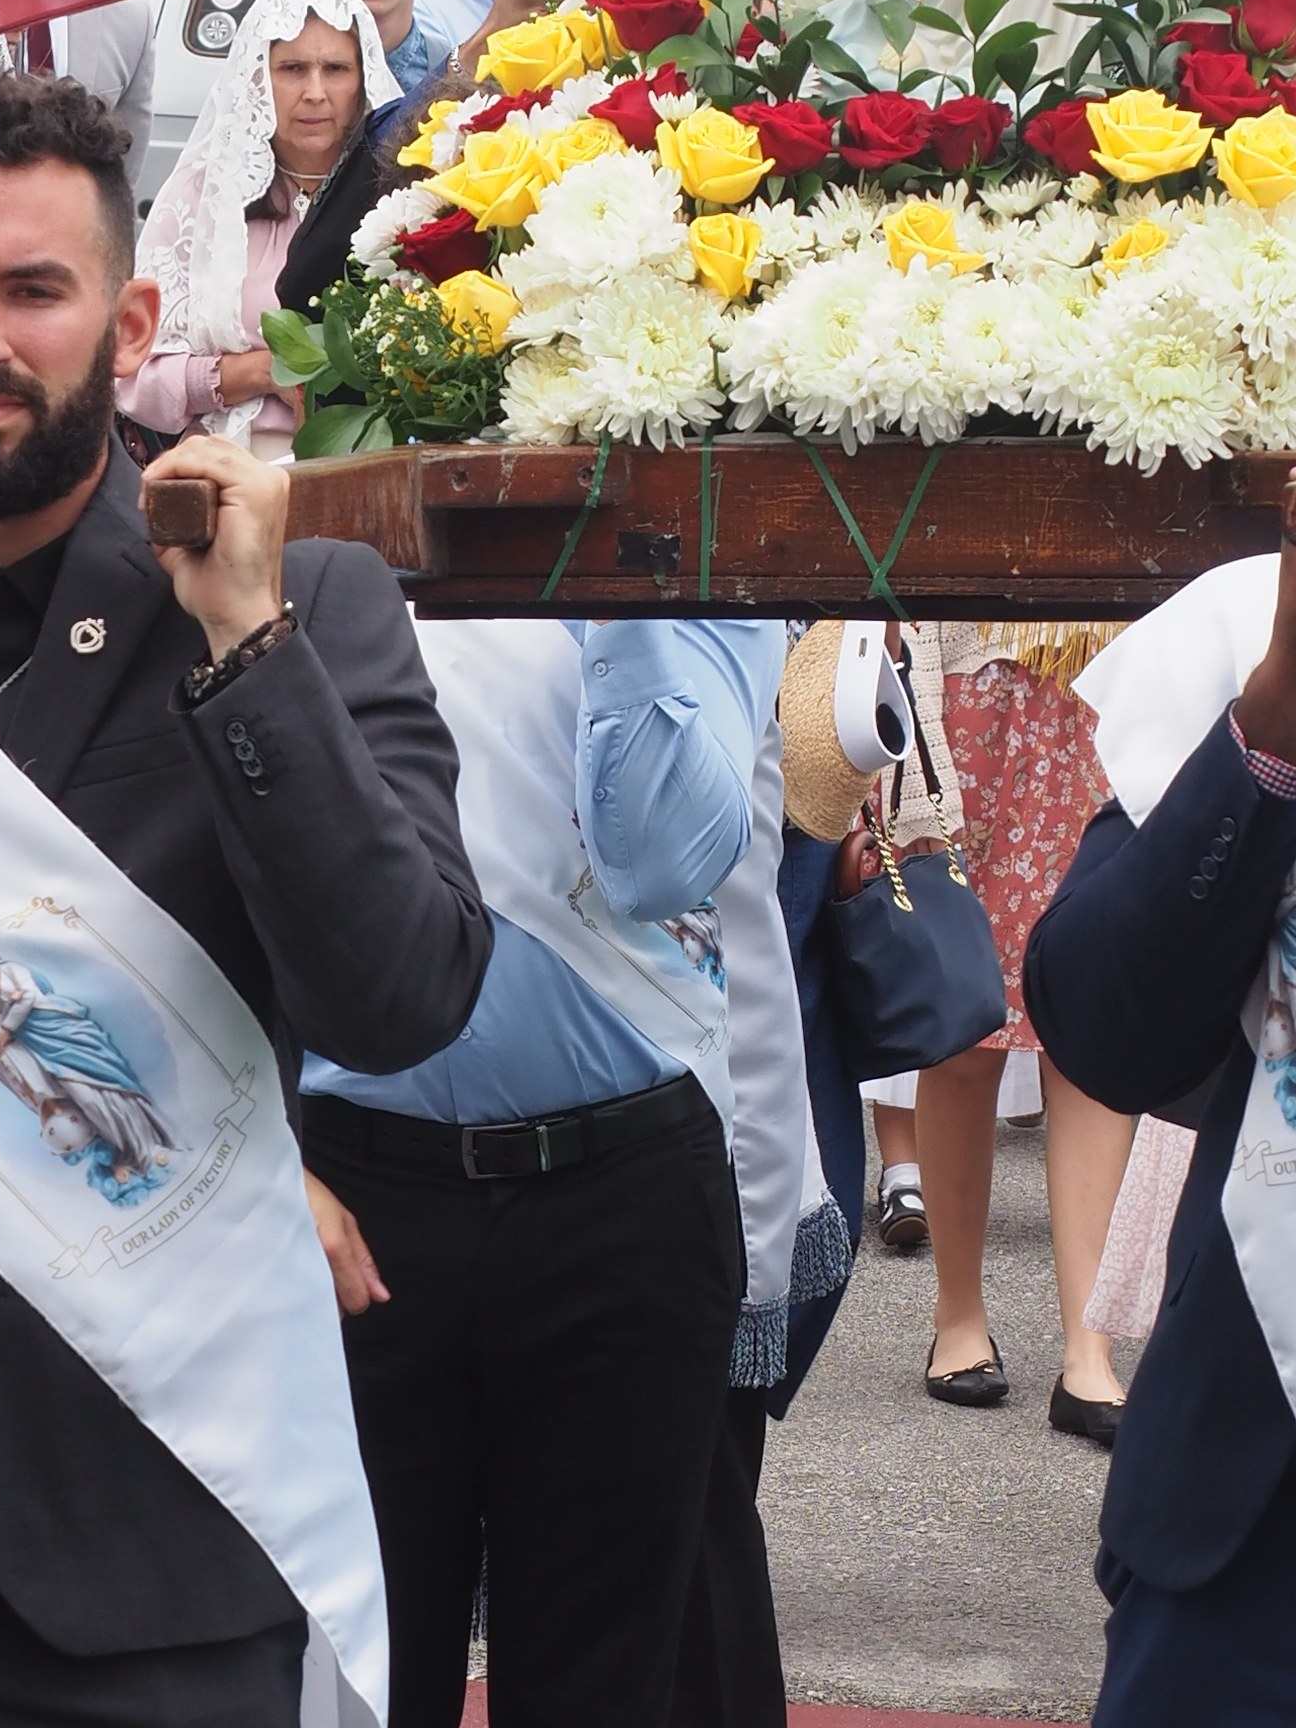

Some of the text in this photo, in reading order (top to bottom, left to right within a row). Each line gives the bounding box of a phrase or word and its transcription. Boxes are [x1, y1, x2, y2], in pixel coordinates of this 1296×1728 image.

[122, 1138, 233, 1254] OUR LADY OF VICTORY
